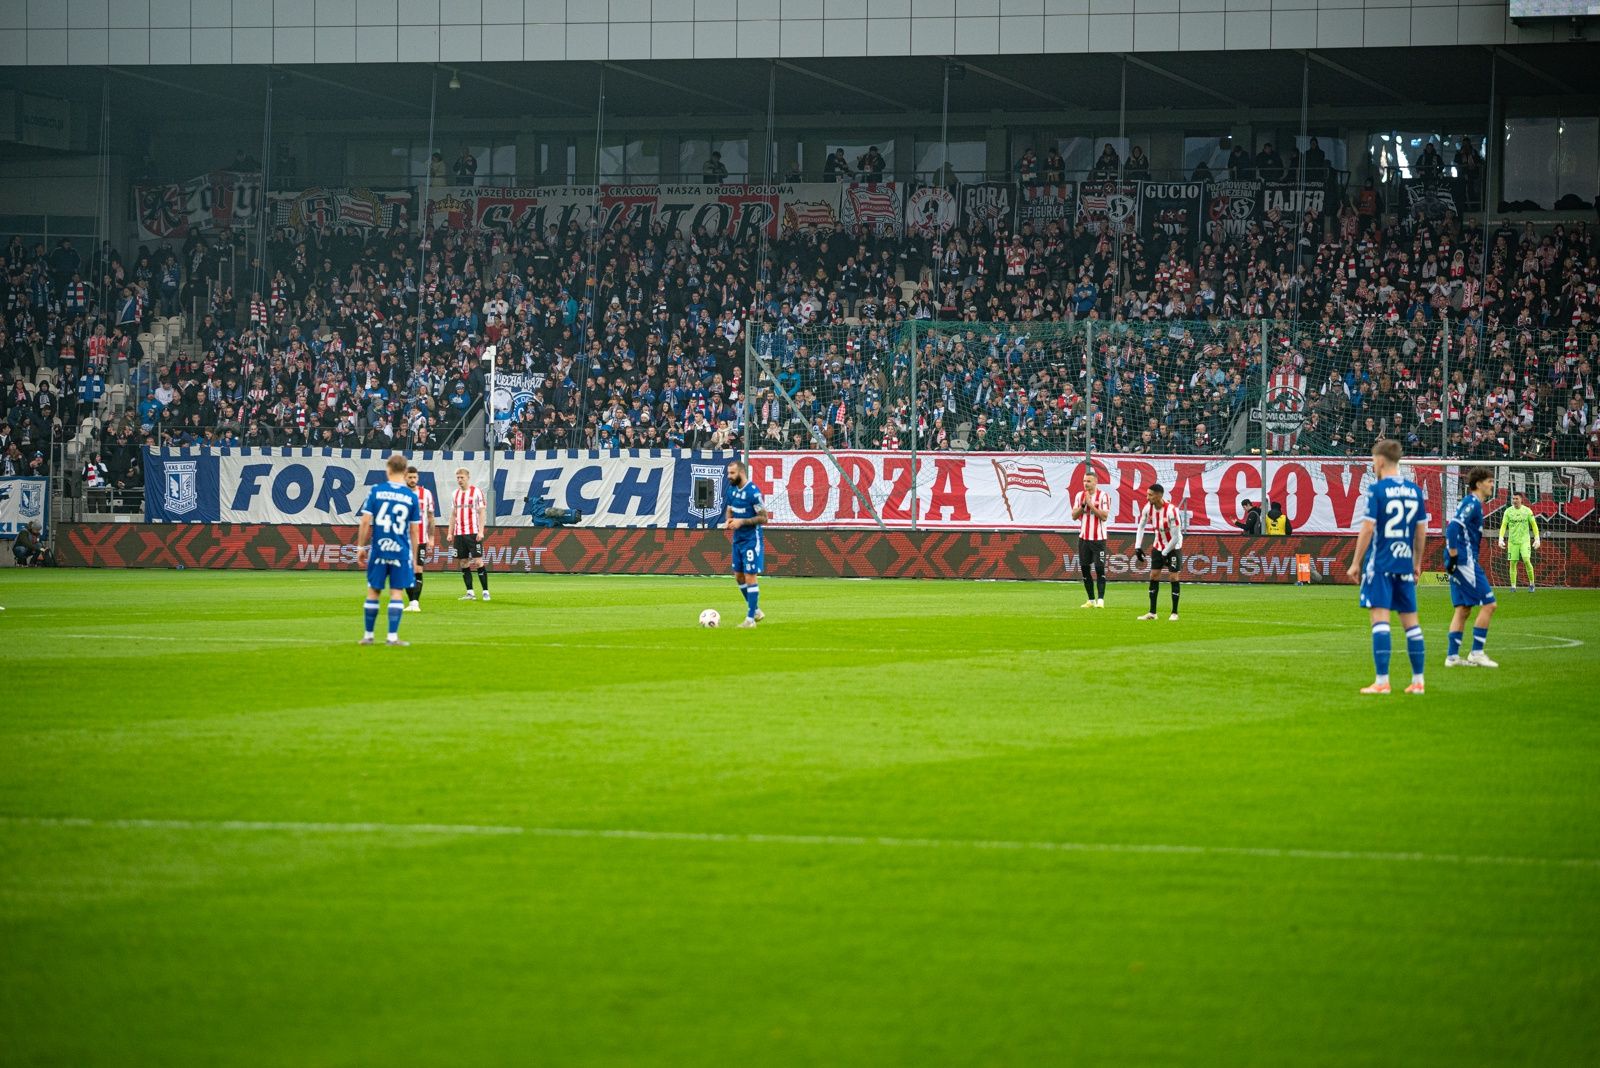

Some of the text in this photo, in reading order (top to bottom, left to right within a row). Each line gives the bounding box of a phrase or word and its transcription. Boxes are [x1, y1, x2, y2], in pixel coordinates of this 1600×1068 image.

[460, 189, 501, 198] ZAWSZE
[562, 188, 567, 196] Z
[609, 186, 661, 196] CRACOVIA
[667, 186, 701, 195] NASZA
[706, 186, 743, 195] DRUGA
[1145, 184, 1199, 199] GUCIO
[1028, 205, 1064, 218] FIGURKA
[493, 465, 664, 517] LECH
[748, 457, 971, 521] FORZA
[1066, 459, 1442, 529] CRACOVA
[375, 501, 409, 535] 43
[1384, 499, 1419, 538] 27
[297, 545, 453, 564] WESCH
[746, 549, 754, 561] 9
[1063, 553, 1233, 576] WSOCH
